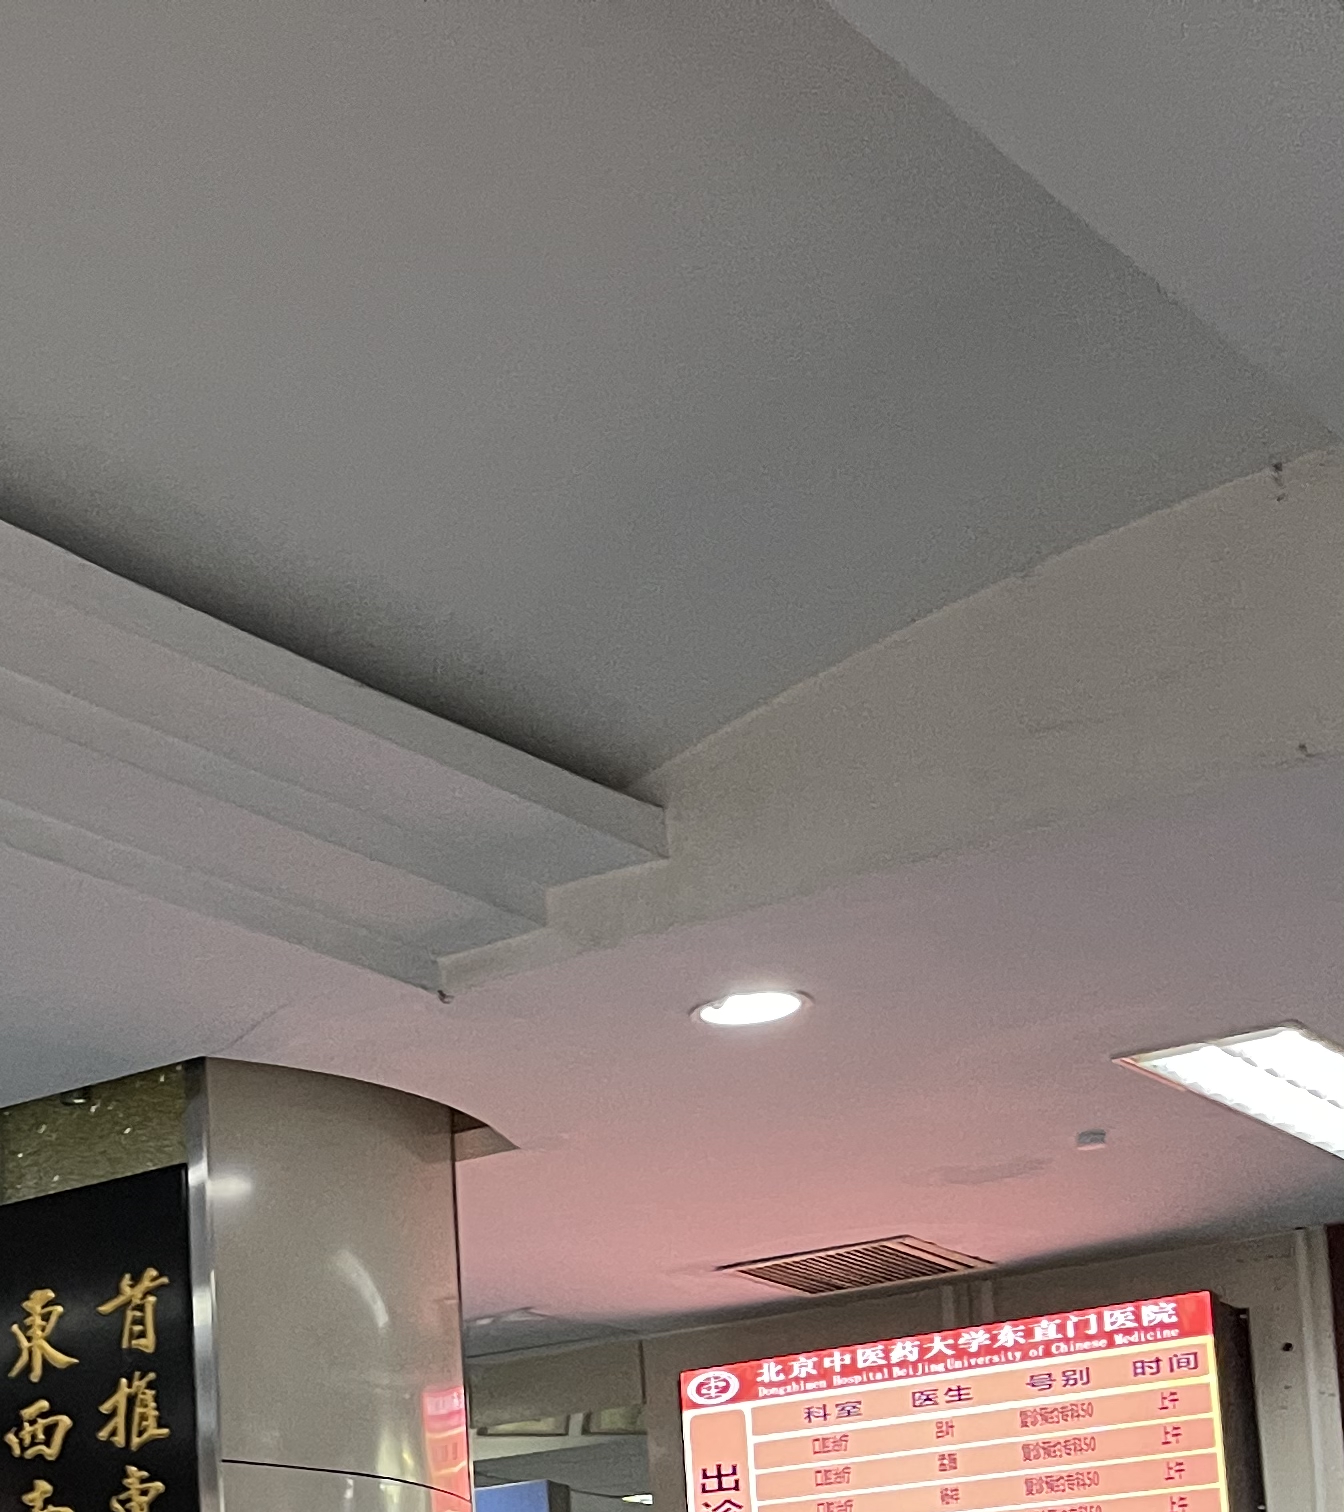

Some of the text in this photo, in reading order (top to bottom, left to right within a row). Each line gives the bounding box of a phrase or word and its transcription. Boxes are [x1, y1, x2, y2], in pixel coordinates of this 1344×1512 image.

[756, 1302, 1180, 1384] 北京中医药大学东直门医院
[833, 1367, 889, 1389] Hospital
[1052, 1338, 1107, 1354] Chinese
[1114, 1327, 1180, 1346] Medicine
[804, 1351, 1199, 1423] 科室 医生 号别 时间
[1158, 1391, 1180, 1411] 上午
[1161, 1425, 1183, 1446] 上午
[1164, 1460, 1186, 1481] 上午
